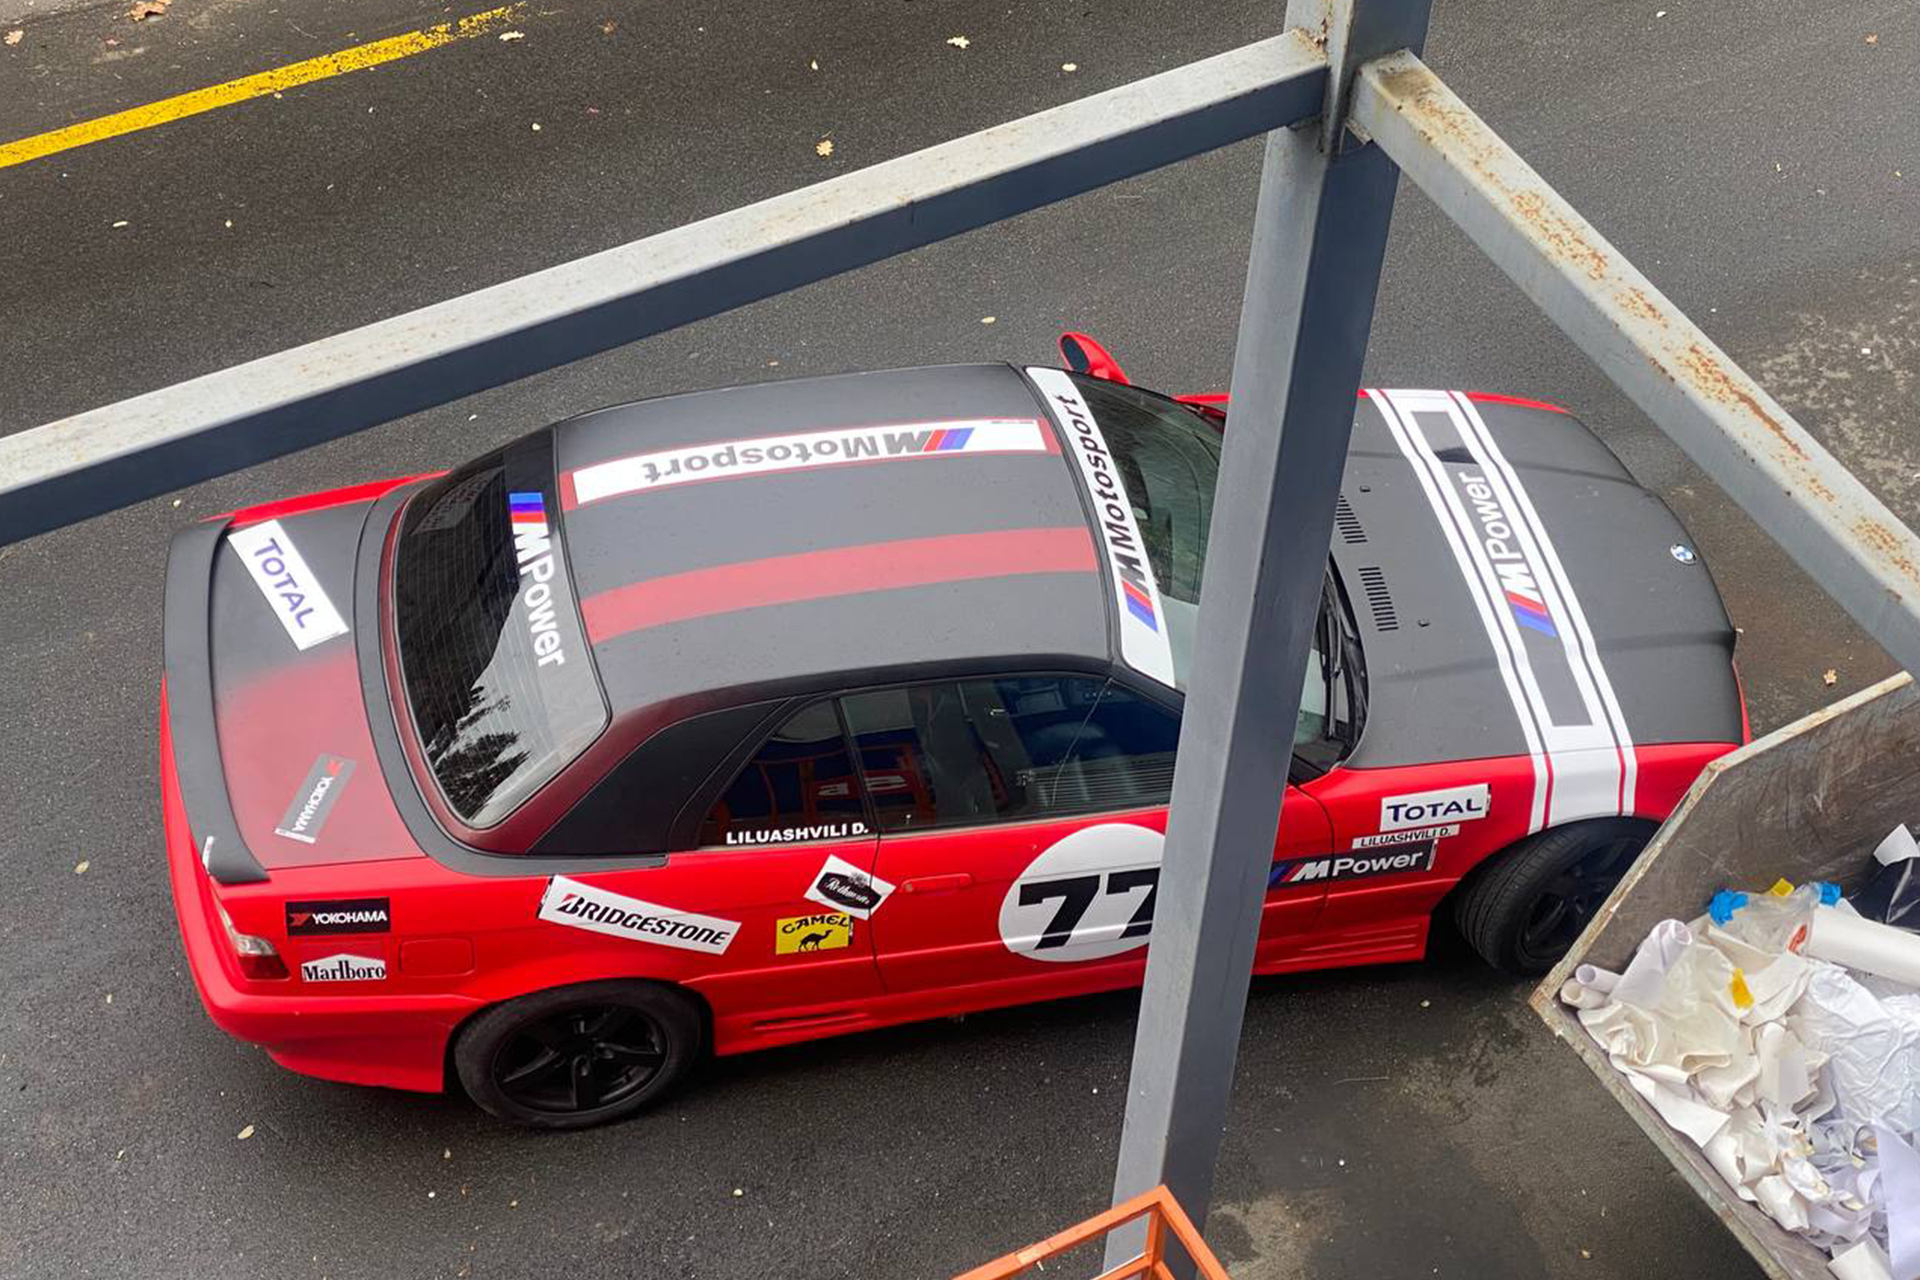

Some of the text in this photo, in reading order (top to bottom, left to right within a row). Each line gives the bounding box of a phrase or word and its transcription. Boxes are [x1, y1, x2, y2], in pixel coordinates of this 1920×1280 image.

[254, 537, 315, 629] TOTAL
[1386, 798, 1483, 822] TOTAL
[726, 822, 869, 844] LILUASHVILI D.
[1361, 827, 1451, 847] LILUASHVILI D.
[312, 910, 388, 925] YOKOHAMA
[557, 893, 731, 946] BRIDGESTONE
[782, 914, 850, 934] CAMEL
[303, 960, 386, 981] Marlboro
